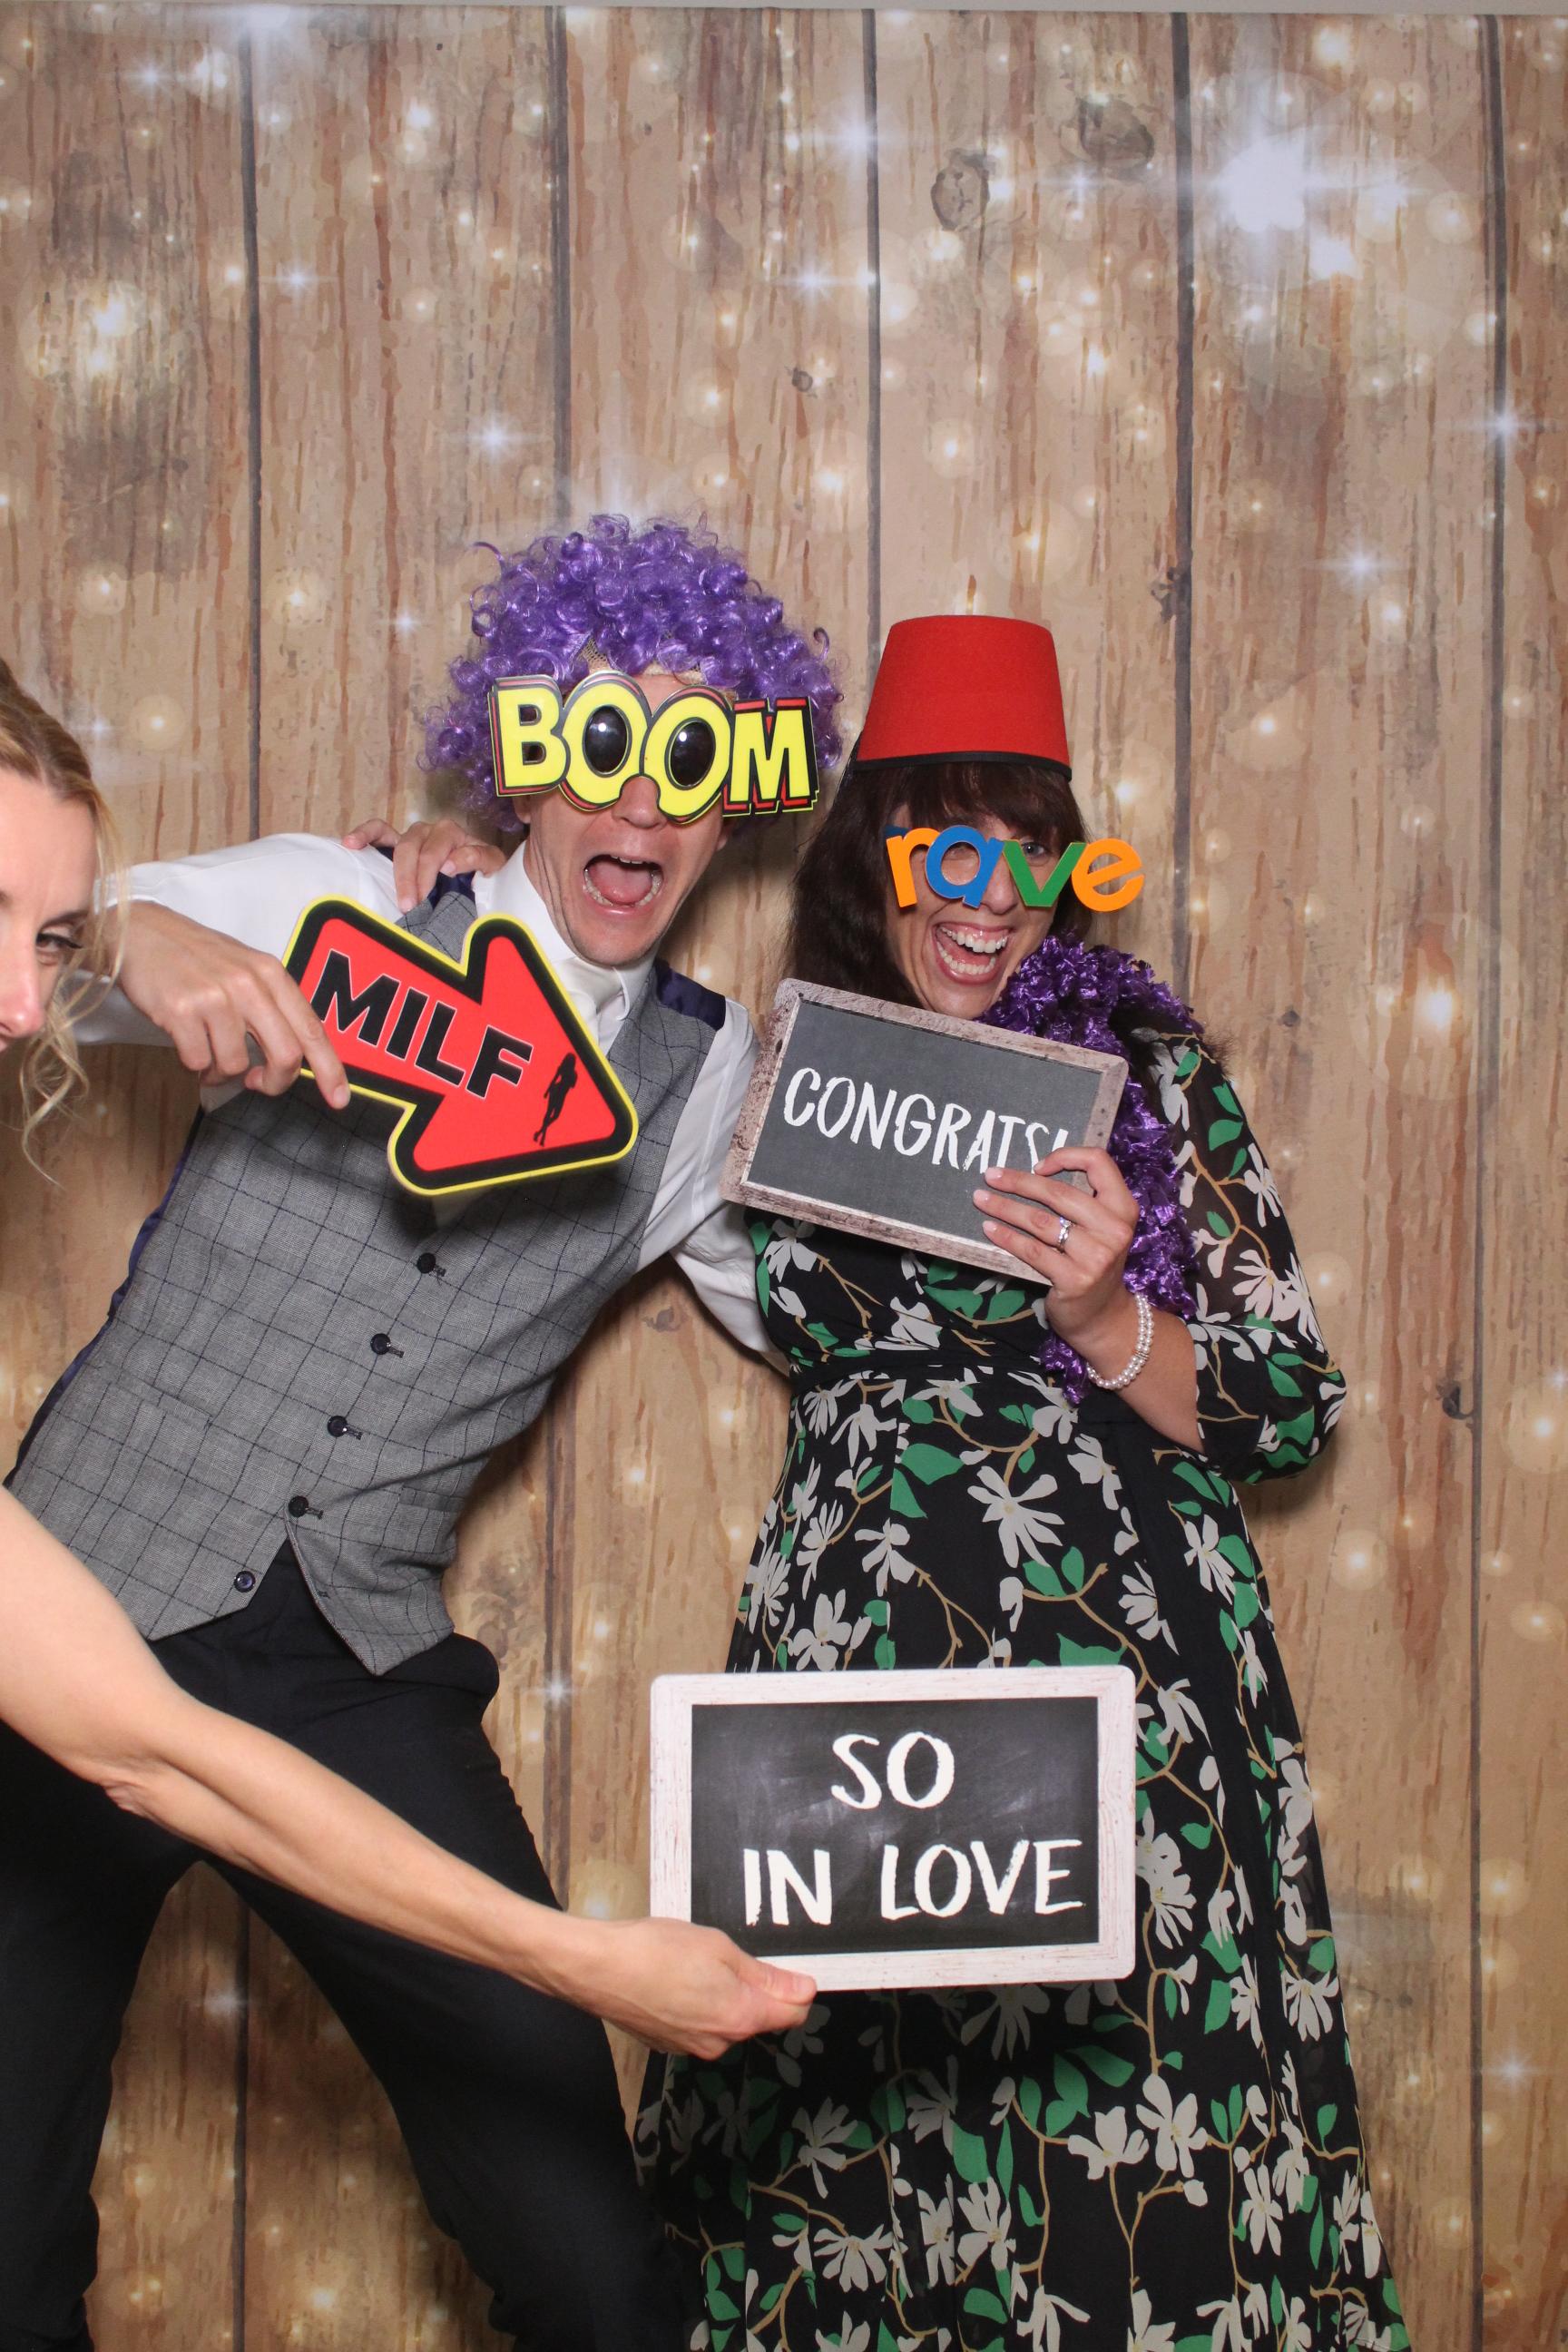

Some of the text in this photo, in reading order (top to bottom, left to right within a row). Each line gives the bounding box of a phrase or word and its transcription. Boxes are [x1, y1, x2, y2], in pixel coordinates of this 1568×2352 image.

[490, 673, 818, 822] BOOM
[886, 824, 1144, 913] rave
[310, 949, 534, 1100] MILF
[831, 1731, 955, 1809] SO
[744, 1839, 1086, 1926] IN LOVE
